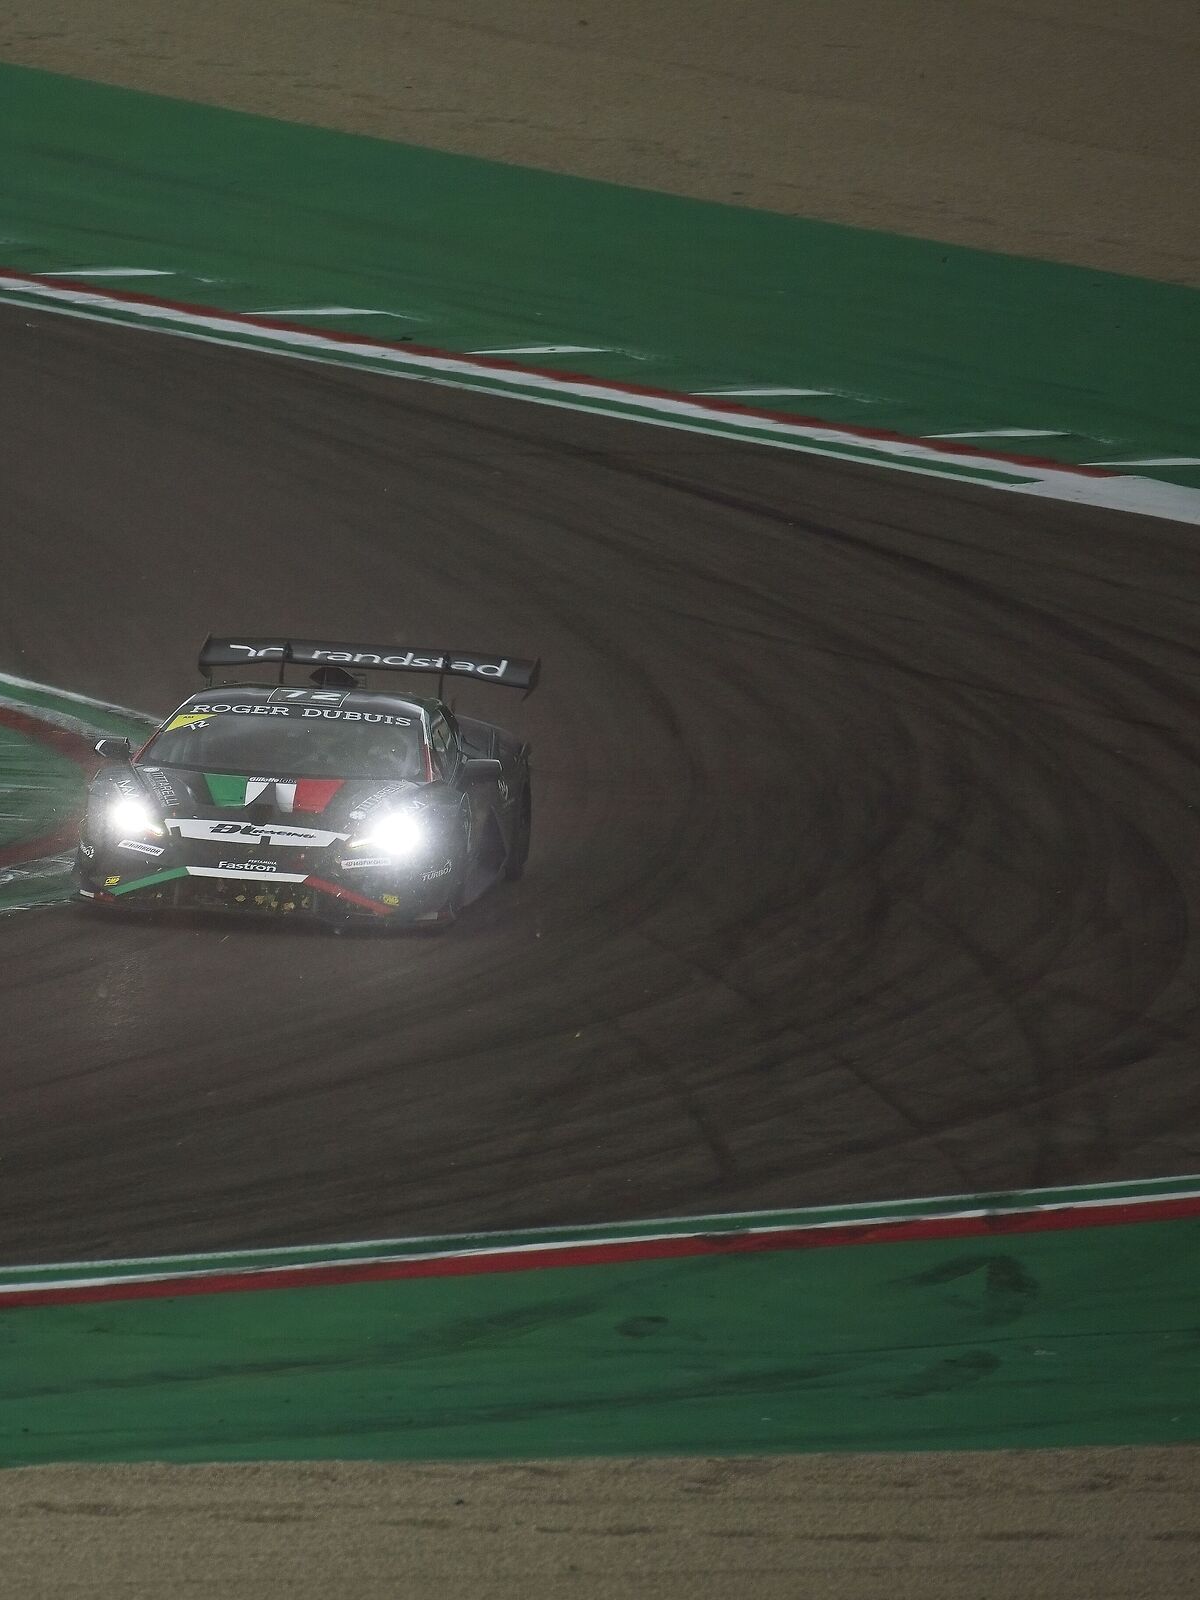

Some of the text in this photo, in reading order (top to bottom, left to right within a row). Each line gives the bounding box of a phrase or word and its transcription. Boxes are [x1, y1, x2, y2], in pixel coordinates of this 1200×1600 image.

[311, 650, 509, 678] randstad
[280, 689, 343, 701] 72
[189, 704, 412, 727] ROGER DUBUIS
[218, 861, 277, 872] Fastron
